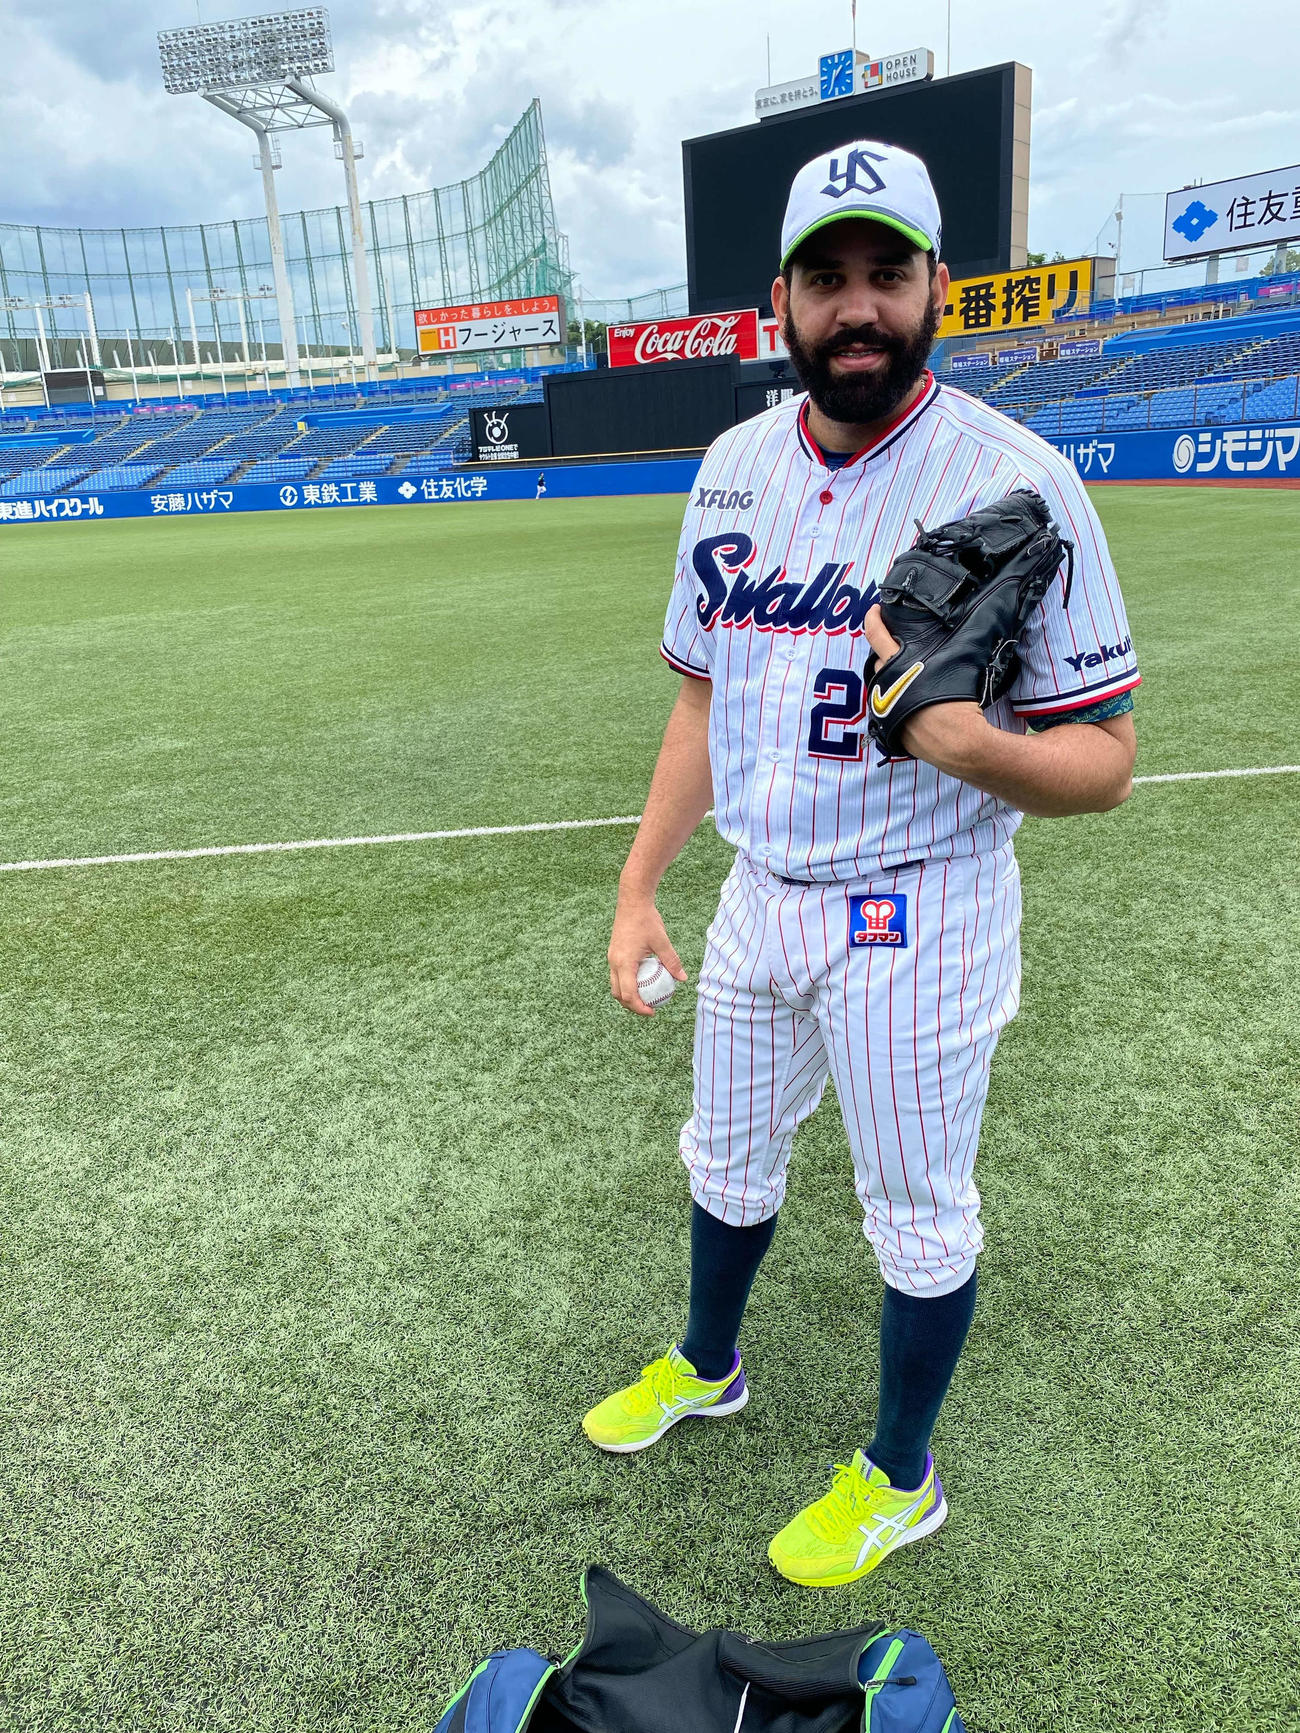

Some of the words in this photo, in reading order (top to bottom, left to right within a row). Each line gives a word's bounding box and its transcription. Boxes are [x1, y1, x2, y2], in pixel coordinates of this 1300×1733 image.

[886, 54, 917, 70] OPEN
[886, 67, 917, 82] HOUSE
[943, 270, 1078, 330] 番搾り
[417, 299, 557, 325] 欲しかった暮らしを、しよう。
[458, 319, 557, 345] フージャース
[614, 327, 635, 339] Enjoy
[634, 314, 742, 364] Coca-Cola
[1052, 440, 1115, 474] ハザマ
[1196, 427, 1300, 472] シモジマ
[302, 482, 378, 505] 東鉄工業
[421, 477, 488, 500] 住友化学
[0, 498, 104, 520] 東進ハイスクール
[150, 490, 234, 513] 安藤ハザマ
[856, 932, 900, 942] タフマン
